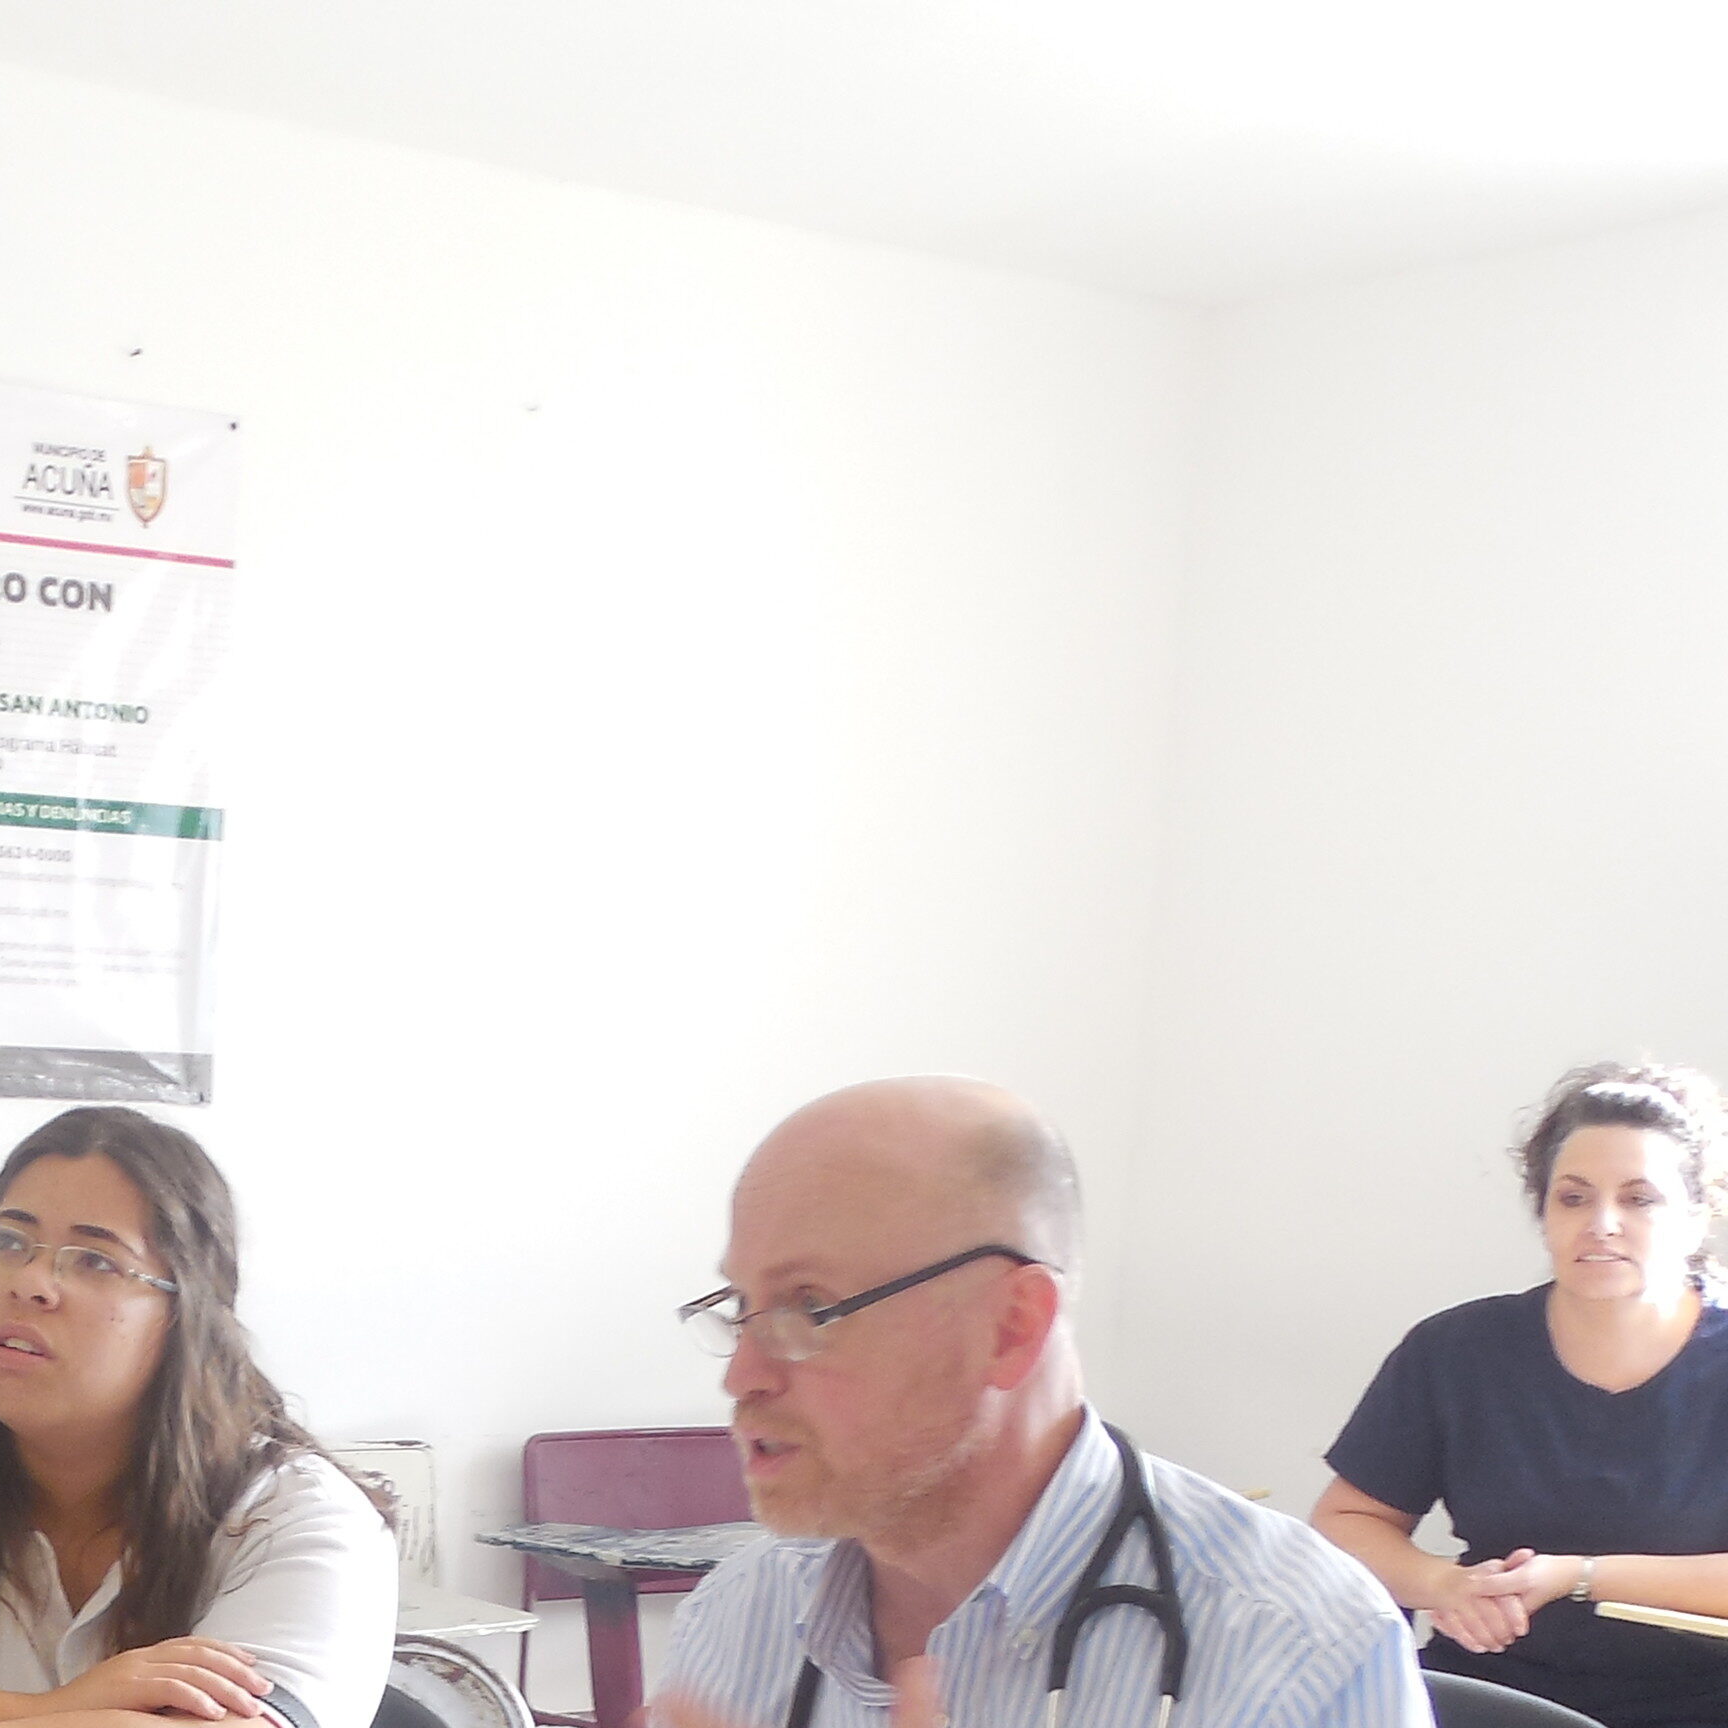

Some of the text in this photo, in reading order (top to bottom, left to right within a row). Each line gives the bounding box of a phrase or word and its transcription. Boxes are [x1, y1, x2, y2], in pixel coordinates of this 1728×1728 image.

[22, 463, 113, 500] ACUÑA
[39, 576, 114, 613] CON
[48, 698, 149, 725] ANTONIO
[39, 803, 133, 825] DENUNCIAS
